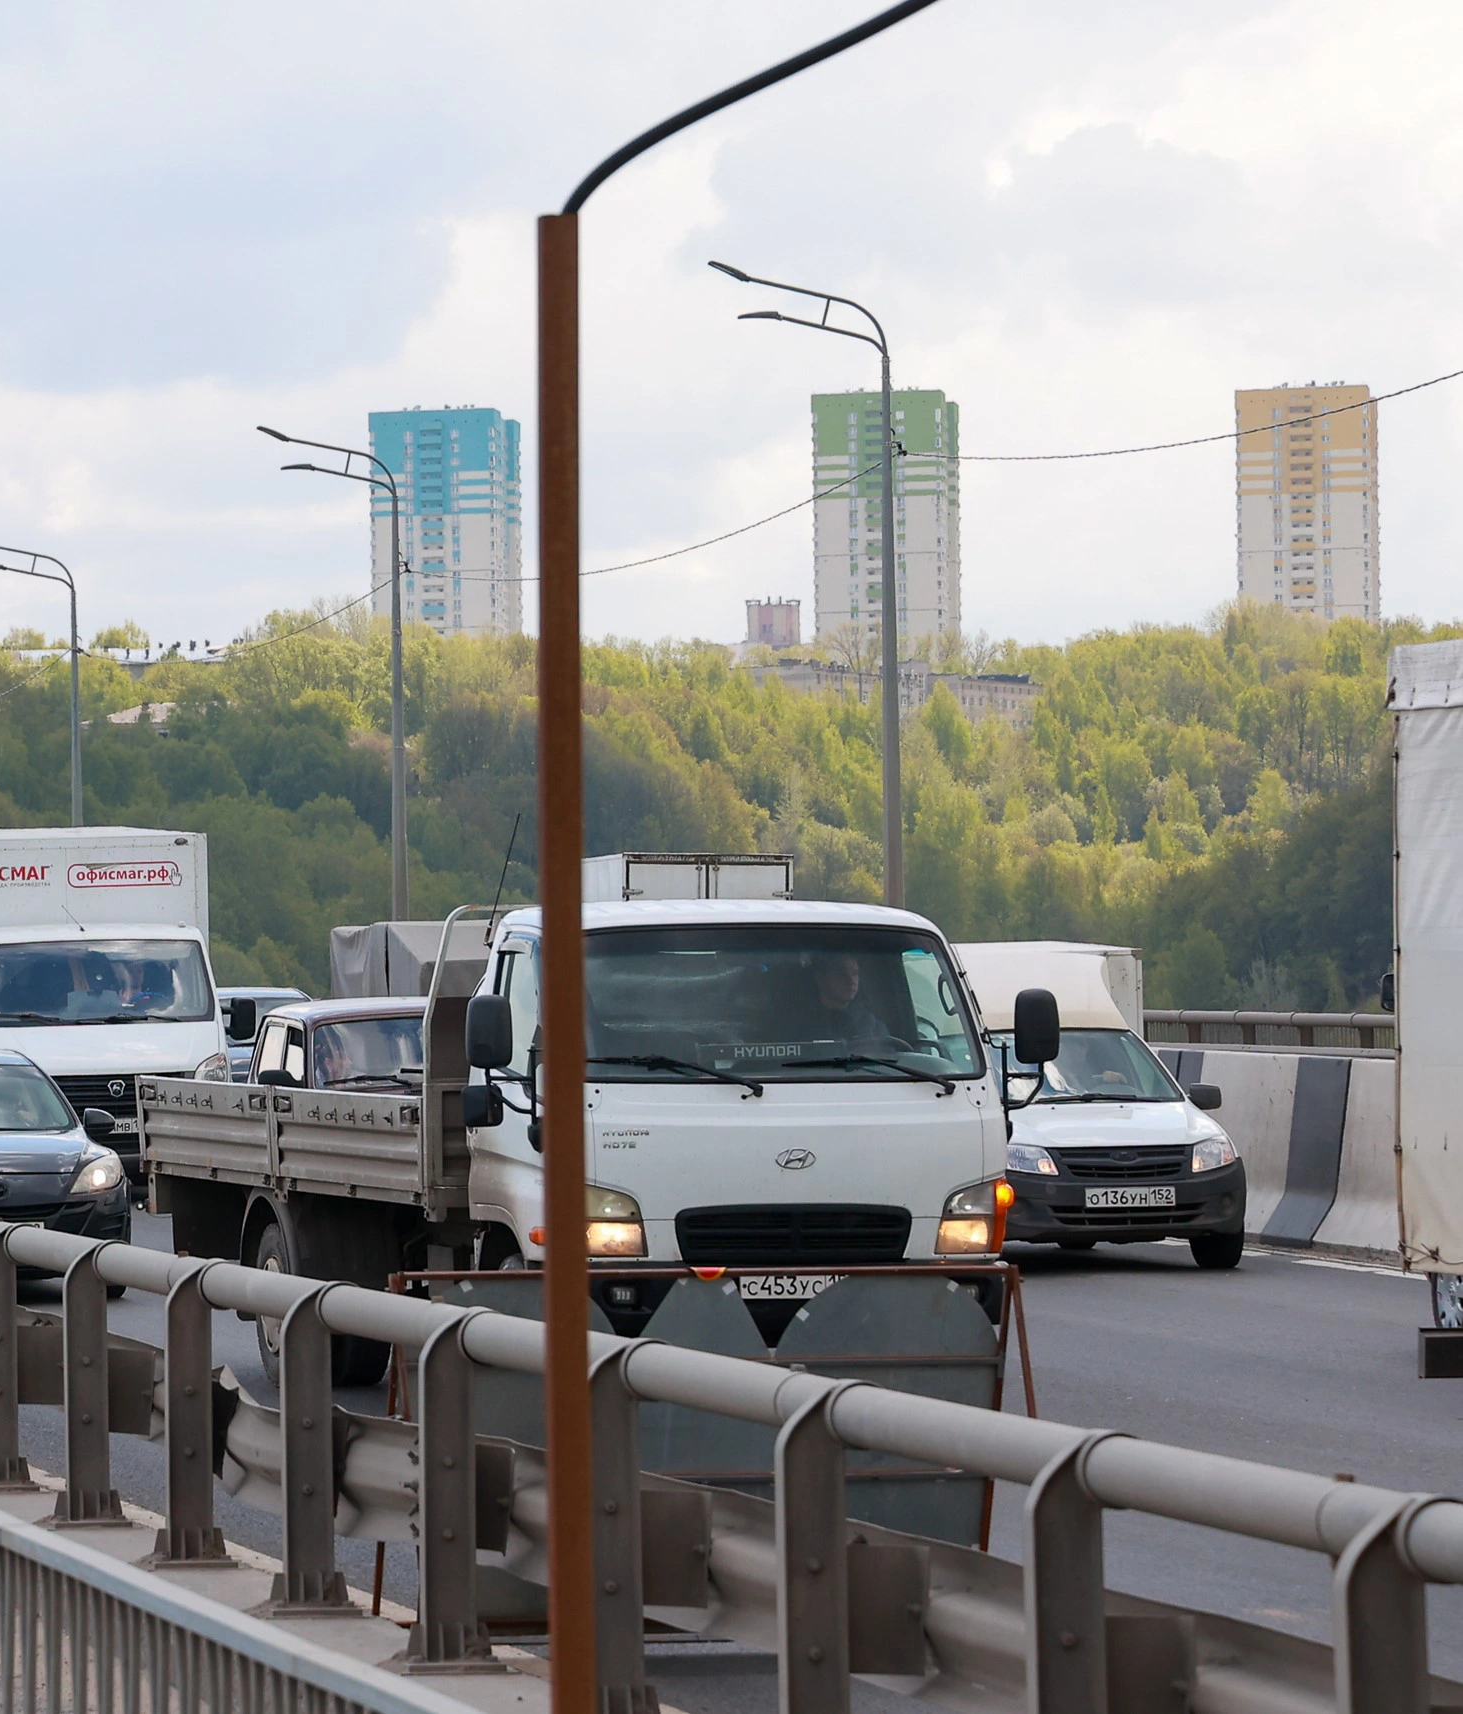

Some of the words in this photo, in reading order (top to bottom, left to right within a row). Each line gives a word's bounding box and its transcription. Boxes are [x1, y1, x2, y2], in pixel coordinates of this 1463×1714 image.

[76, 866, 169, 883] офисмаг.рф
[734, 1045, 801, 1058] HYUNDAI
[602, 1128, 650, 1137] HYUNDAI
[1150, 1188, 1172, 1200] 152
